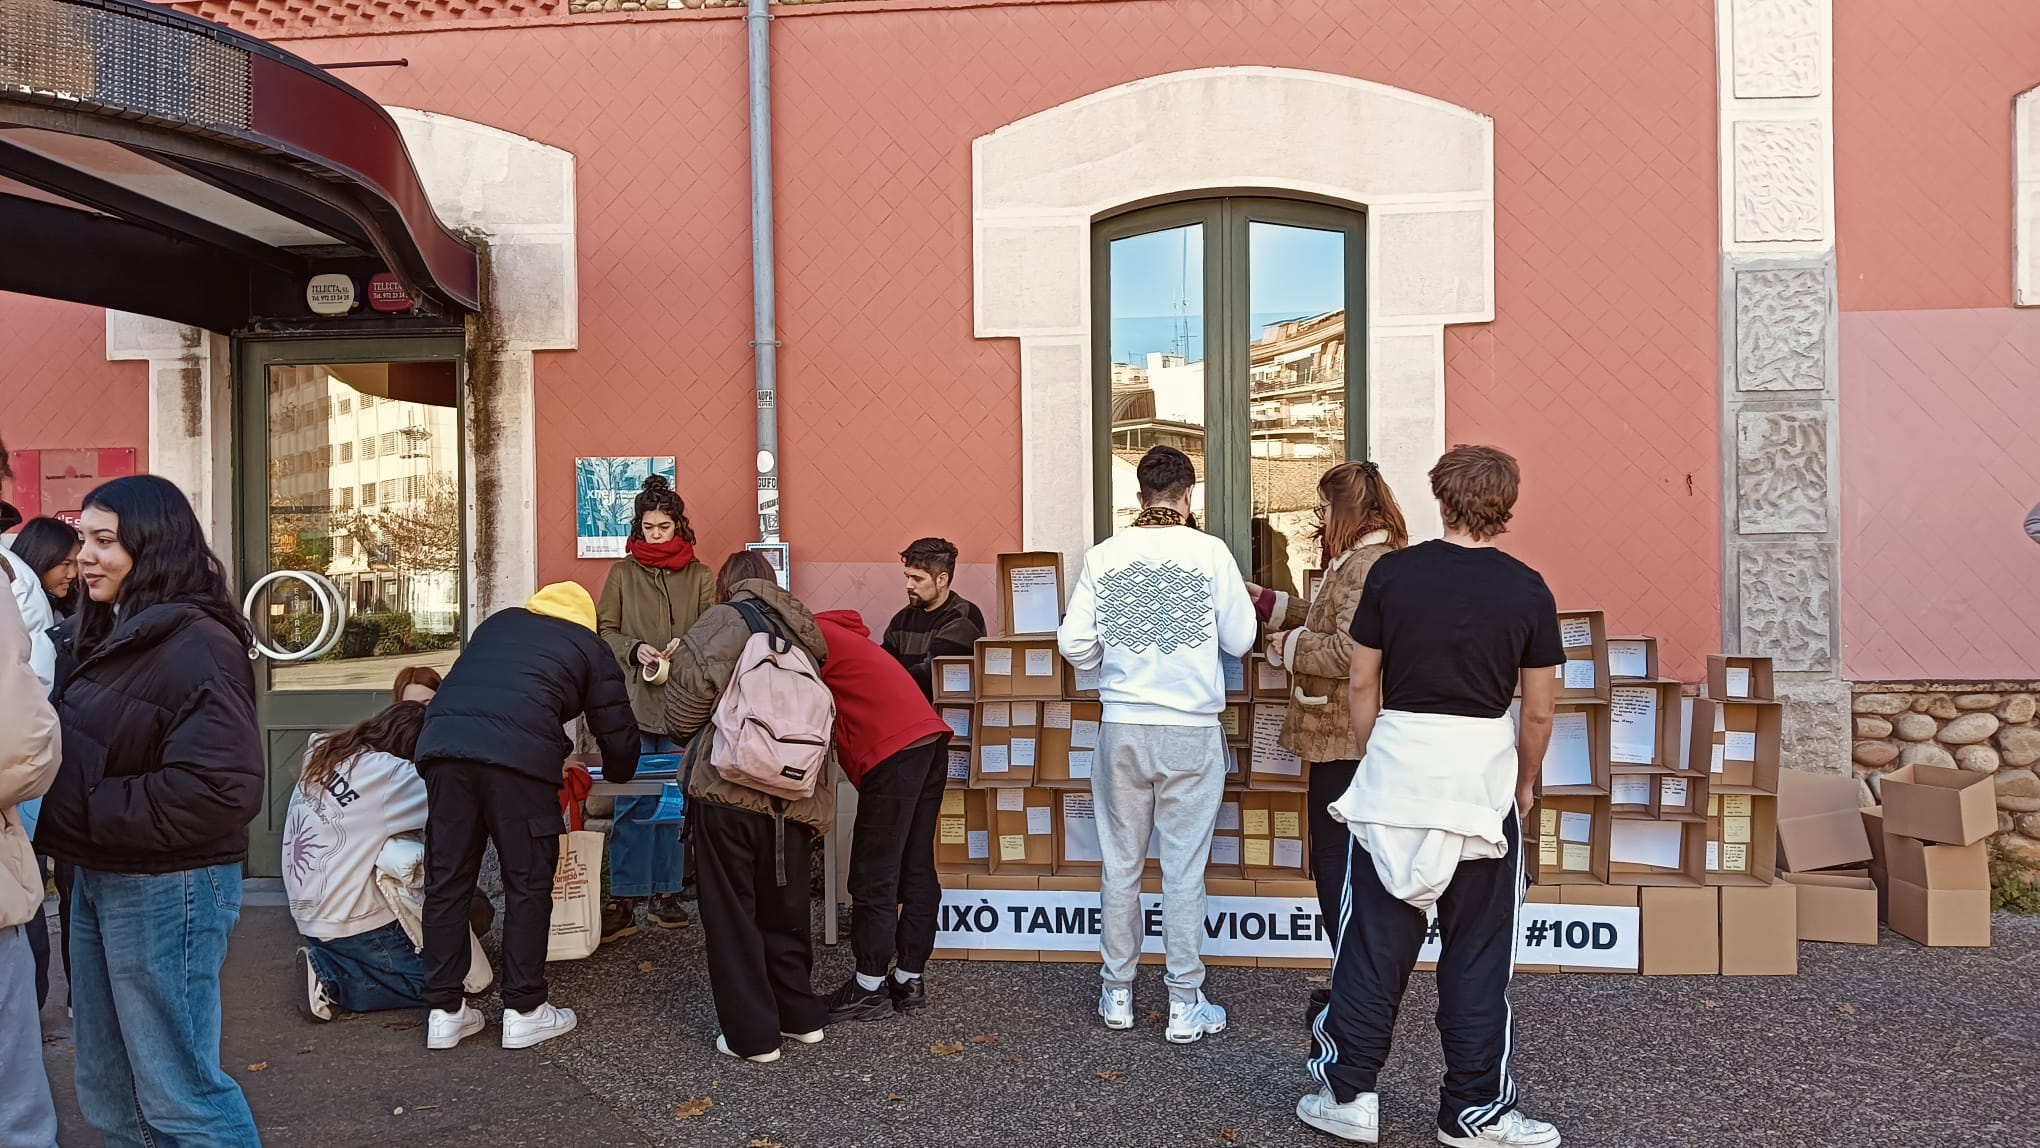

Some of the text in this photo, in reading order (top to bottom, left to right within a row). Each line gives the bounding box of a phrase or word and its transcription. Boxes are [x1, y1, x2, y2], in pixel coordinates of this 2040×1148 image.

[937, 899, 999, 934] IXÒ
[1144, 902, 1163, 937] É
[1525, 919, 1618, 950] #10D
